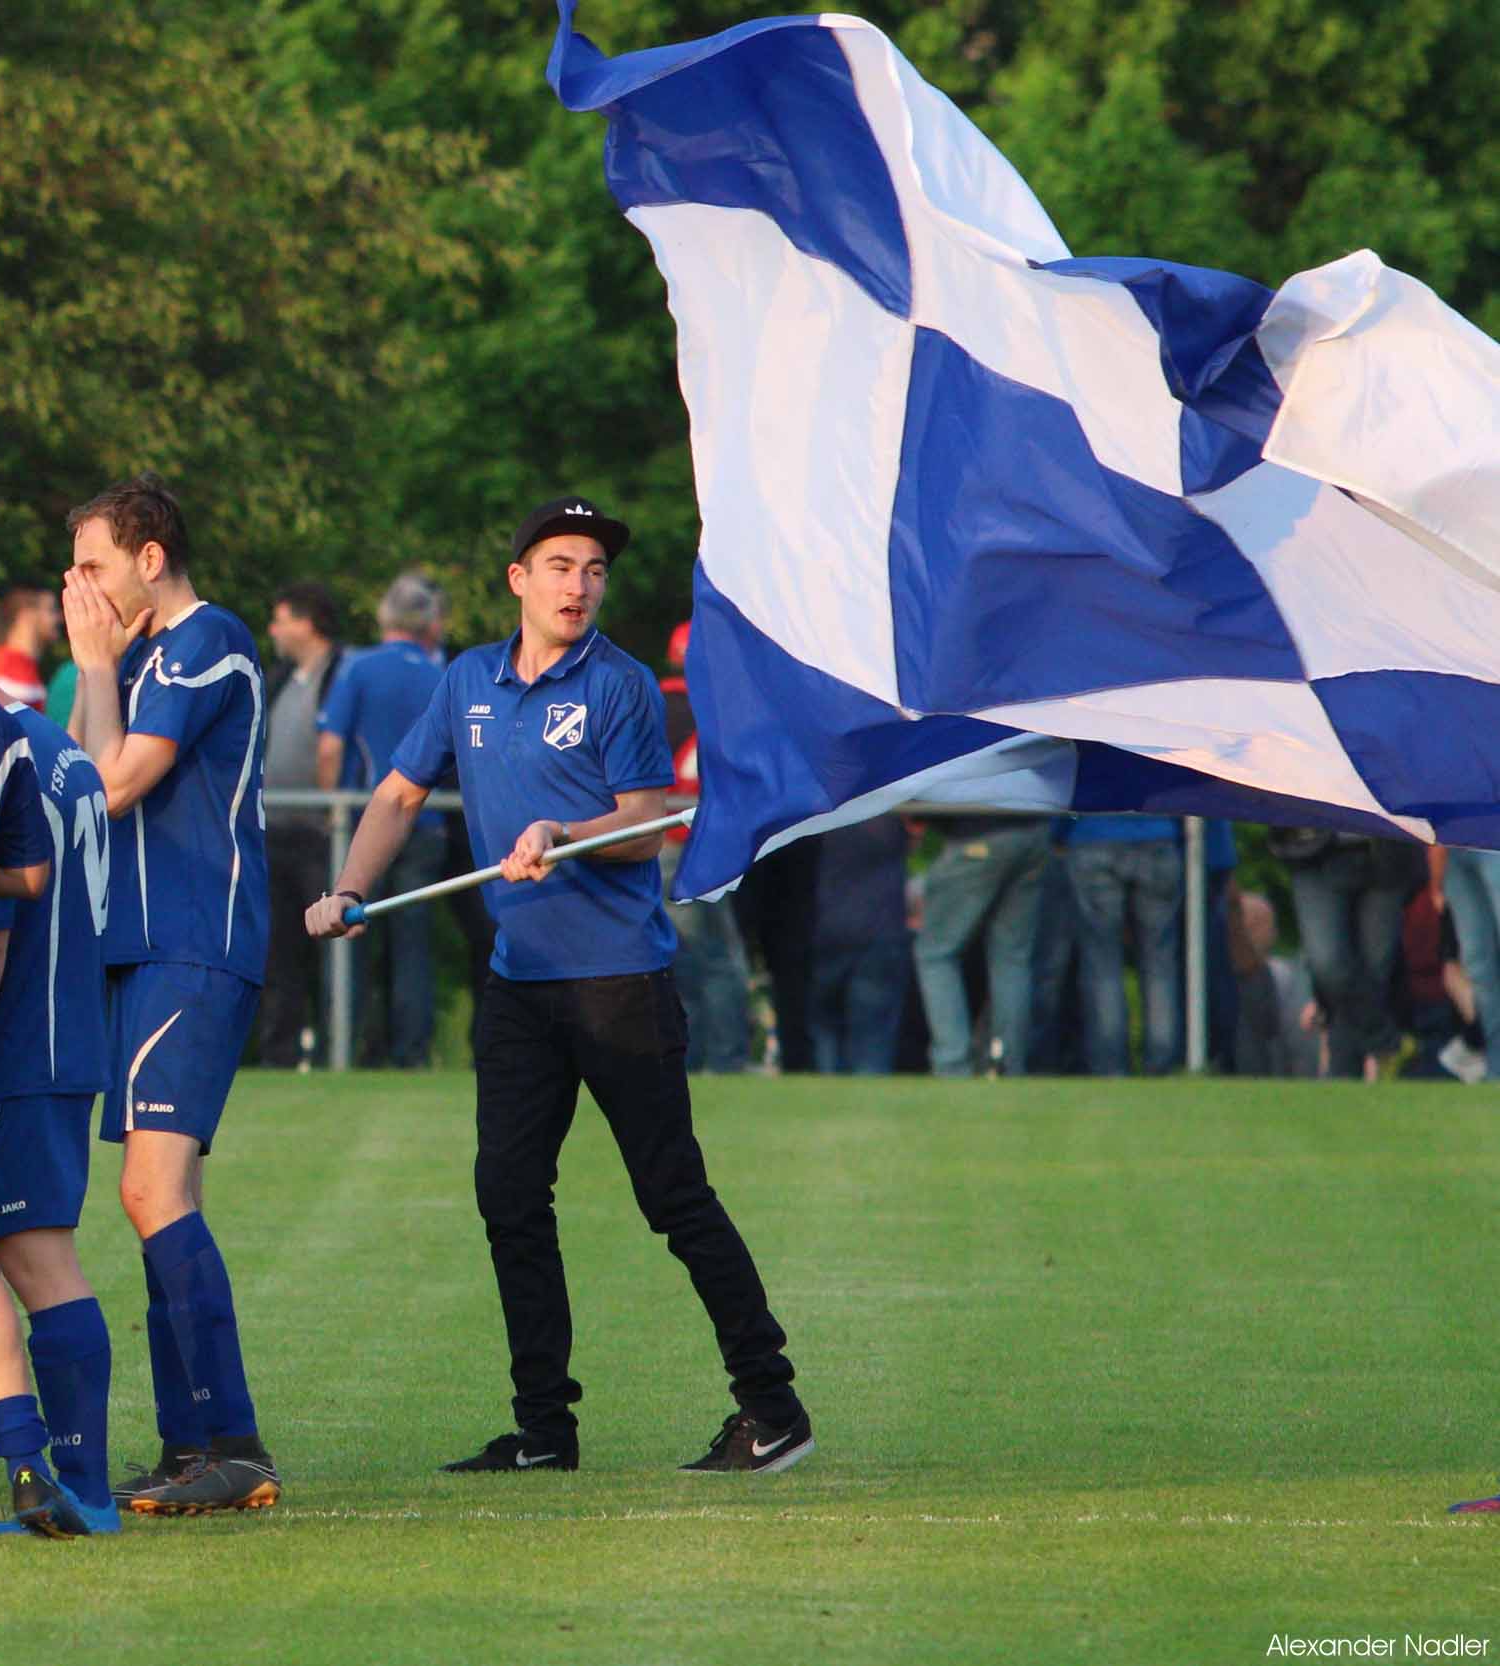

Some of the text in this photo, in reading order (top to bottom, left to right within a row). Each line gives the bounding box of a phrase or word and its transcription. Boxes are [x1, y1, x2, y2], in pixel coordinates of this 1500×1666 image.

[469, 723, 484, 748] TL
[147, 1102, 175, 1114] JAKO
[0, 1200, 27, 1215] JAKO
